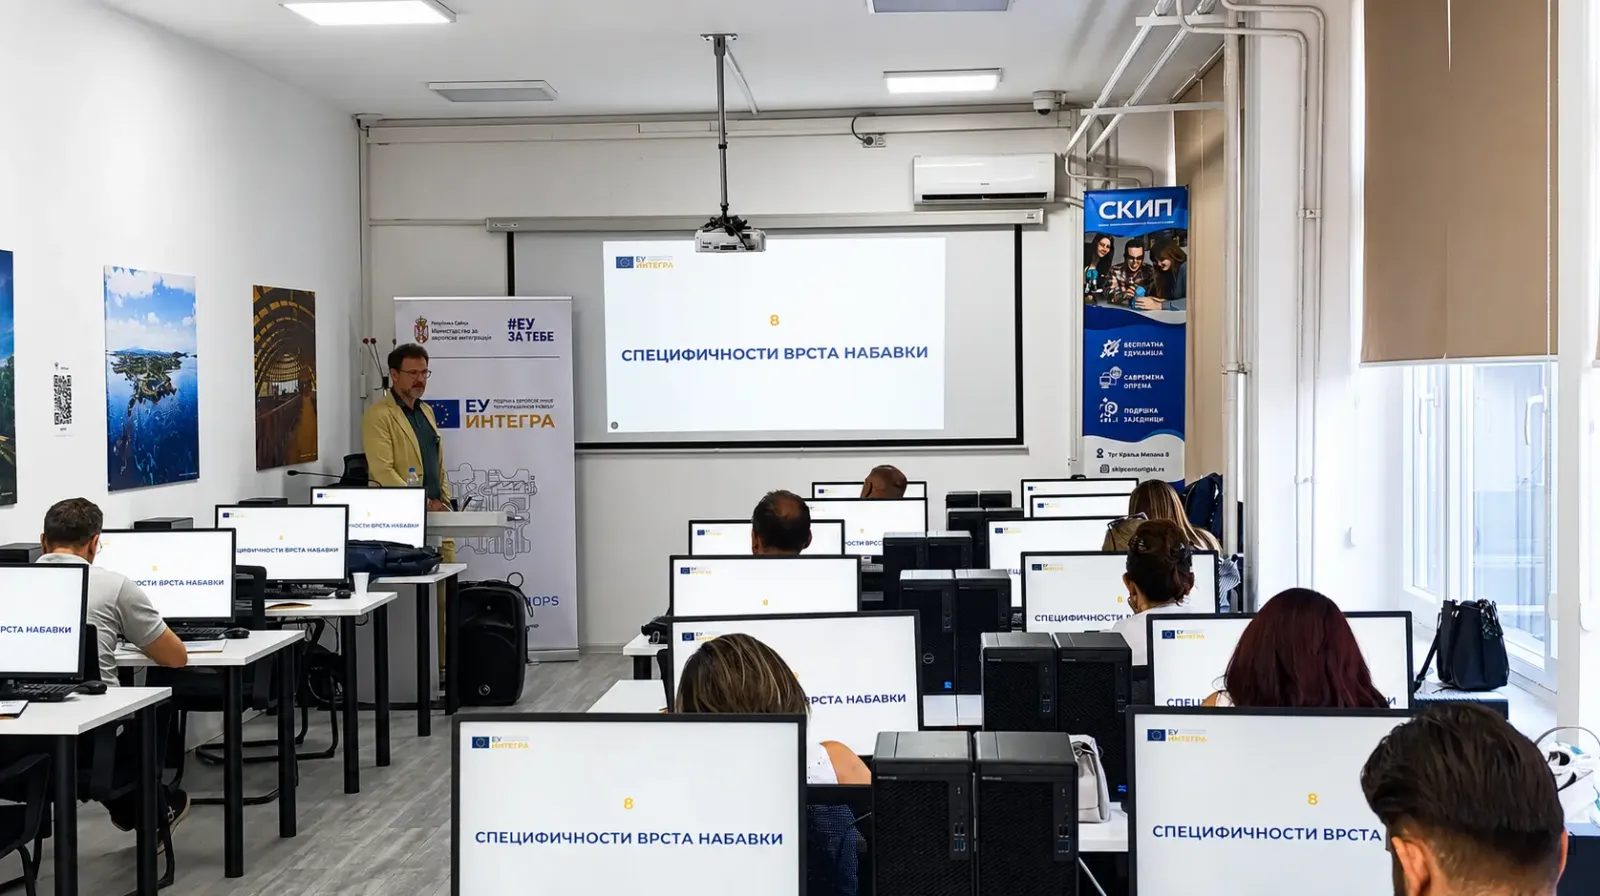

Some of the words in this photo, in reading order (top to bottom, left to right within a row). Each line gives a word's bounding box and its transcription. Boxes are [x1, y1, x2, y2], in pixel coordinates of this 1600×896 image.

[1098, 198, 1173, 220] СКИП
[507, 318, 536, 330] #ЕУ
[769, 314, 780, 326] 8
[507, 331, 523, 342] ЗА
[525, 331, 554, 342] ТЕБЕ
[621, 347, 779, 363] СПЕЦИФИЧНОСТИ
[784, 347, 840, 360] ВРСТА
[844, 346, 929, 360] НАБАВКИ
[465, 399, 490, 413] ЕУ
[465, 414, 556, 429] ИНТЕГРА
[1034, 613, 1124, 622] СПЕЦИФИЧНОСТИ
[26, 626, 72, 634] НАБАВКИ
[846, 693, 907, 704] НАБАВКИ
[623, 797, 634, 810] 8
[1307, 793, 1318, 806] 8
[475, 831, 632, 846] СПЕЦИФИЧНОСТИ
[638, 832, 694, 845] ВРСТА
[699, 832, 784, 846] НАБАВКИ
[1152, 825, 1318, 841] СПЕЦИФИЧНОСТИ
[1323, 828, 1383, 842] ВРСТА
